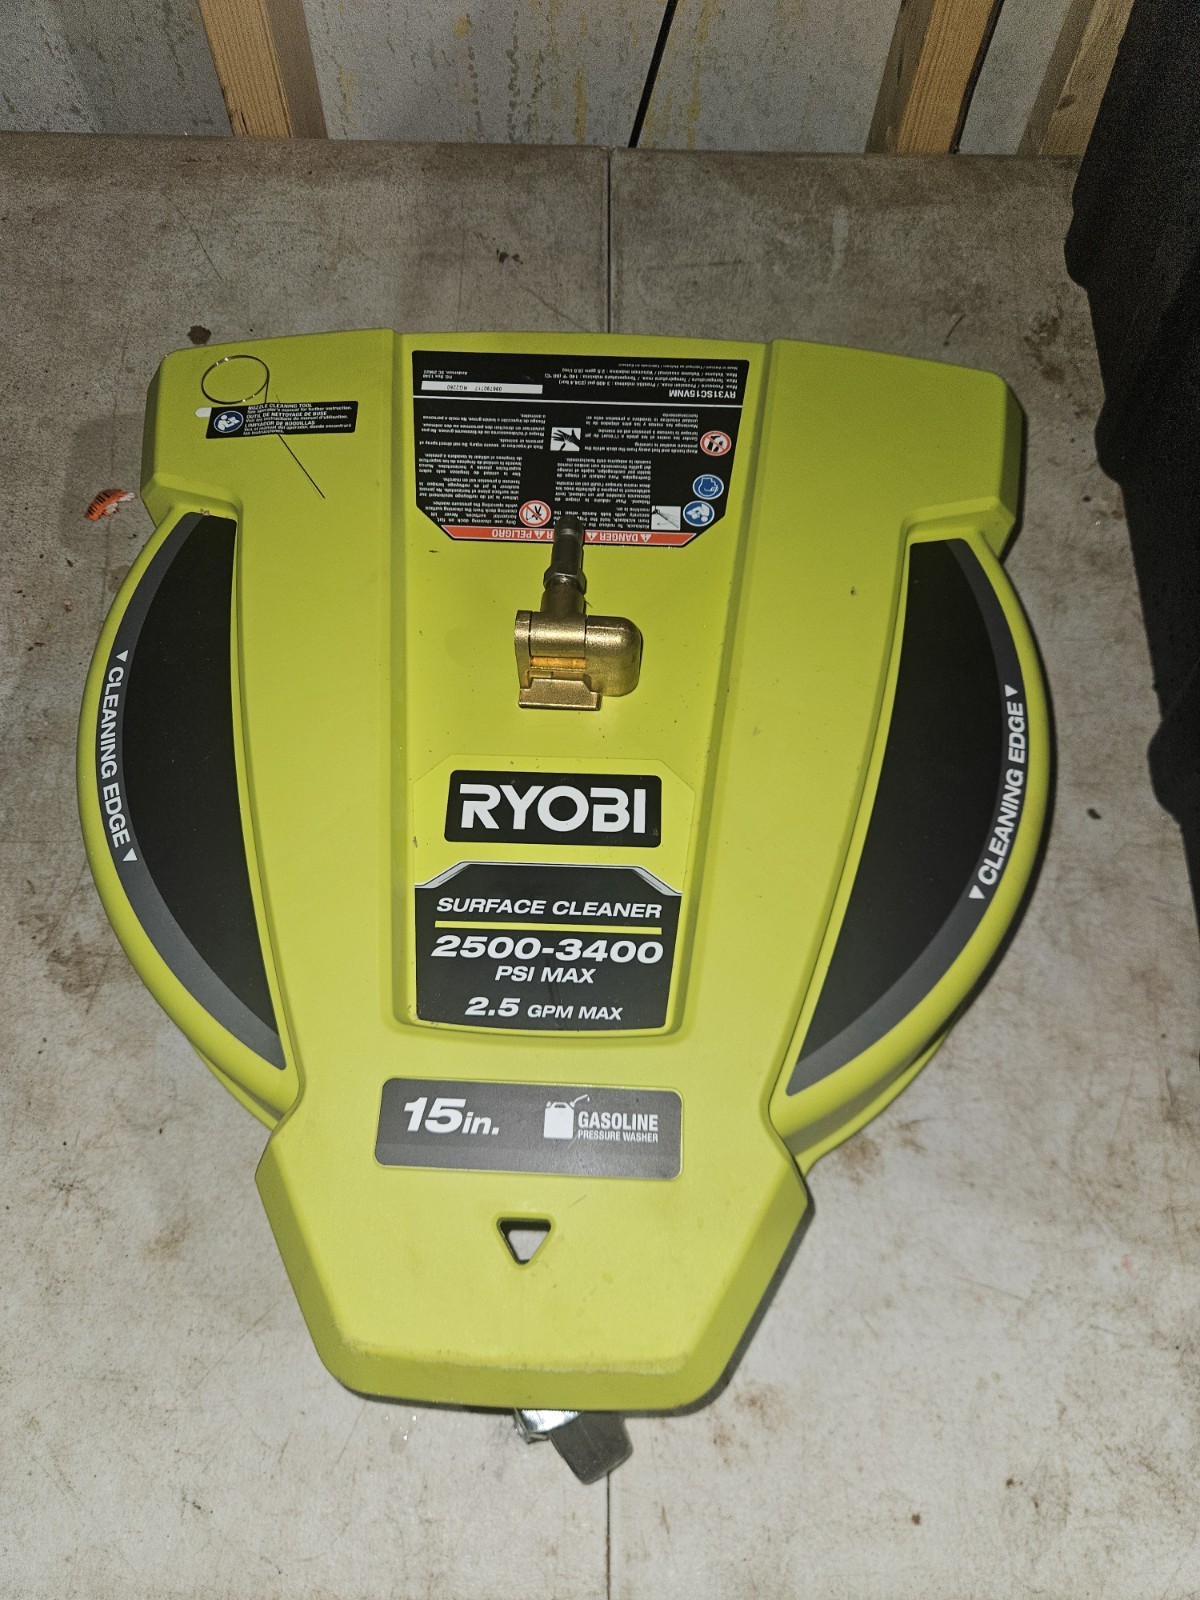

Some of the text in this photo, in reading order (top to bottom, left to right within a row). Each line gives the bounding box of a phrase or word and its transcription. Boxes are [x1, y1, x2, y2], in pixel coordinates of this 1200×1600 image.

[669, 389, 736, 399] RY31SC15VNM
[492, 529, 532, 538] PELIGRO
[600, 532, 638, 542] DANGER
[101, 667, 130, 848] CLEANING EDGE
[978, 701, 1026, 886] CLEANING EDGE
[459, 783, 646, 834] RYOBI
[437, 897, 662, 918] SURFACE CLEANER
[430, 935, 664, 964] 2500-3400
[494, 966, 597, 984] PSI MAX
[464, 997, 623, 1020] 2.5 GPM MAX
[578, 1111, 658, 1132] GASOLINE
[578, 1130, 658, 1143] PRESSURE WASHER
